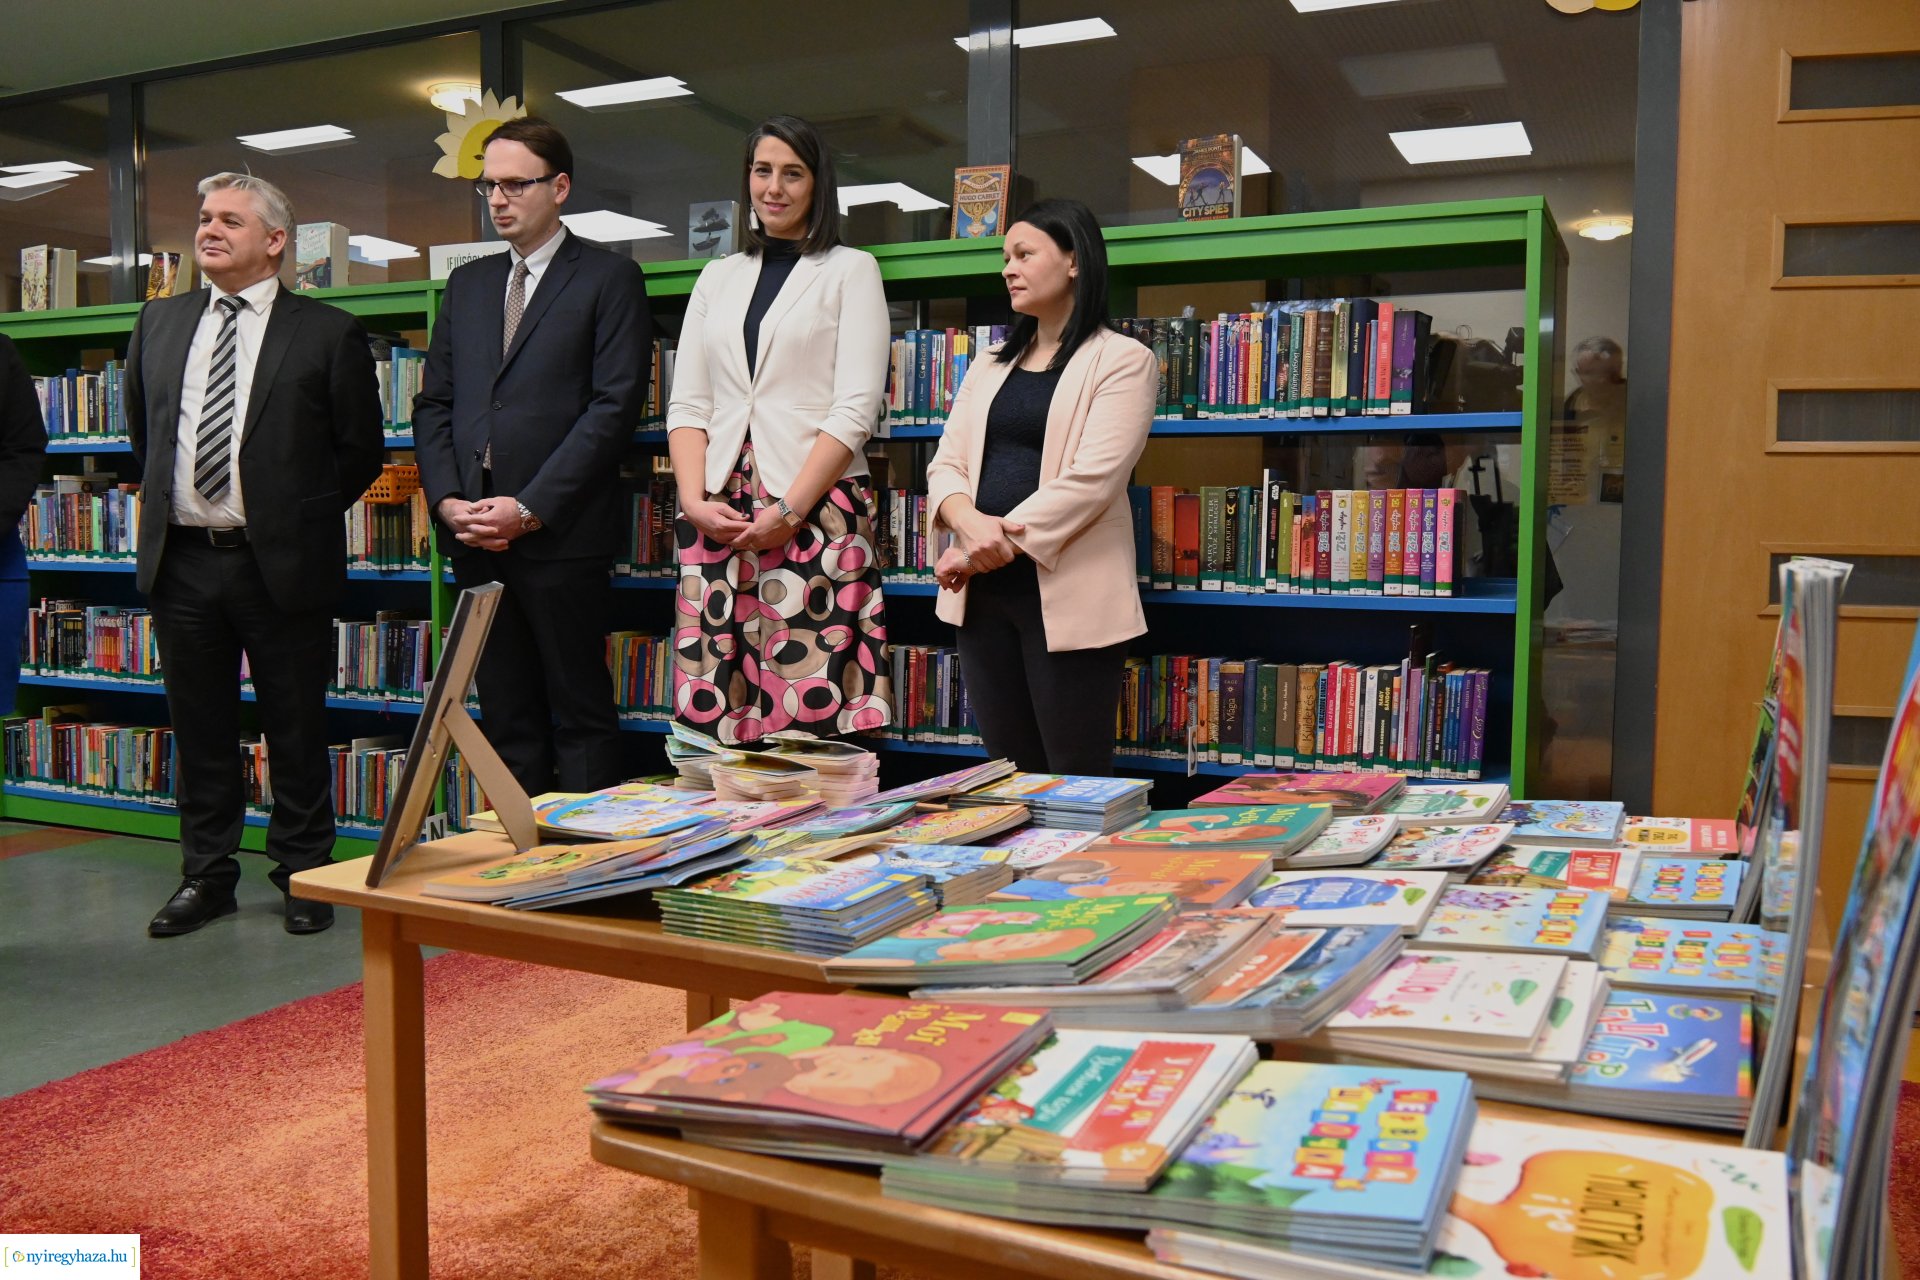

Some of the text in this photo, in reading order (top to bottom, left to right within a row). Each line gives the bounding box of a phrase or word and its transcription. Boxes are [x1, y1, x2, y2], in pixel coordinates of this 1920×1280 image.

[1183, 204, 1229, 217] CITY SPIES
[652, 504, 662, 536] ATTILA
[664, 502, 674, 532] ATTILA
[1227, 698, 1238, 722] Mágia
[1302, 694, 1314, 742] Küldetés
[430, 819, 444, 840] N
[905, 1010, 986, 1046] Мої
[1298, 1088, 1368, 1177] ШАПОЧКА
[1367, 1091, 1434, 1180] ЧЕРВОНА
[1572, 1174, 1650, 1265] МОНСТРИК
